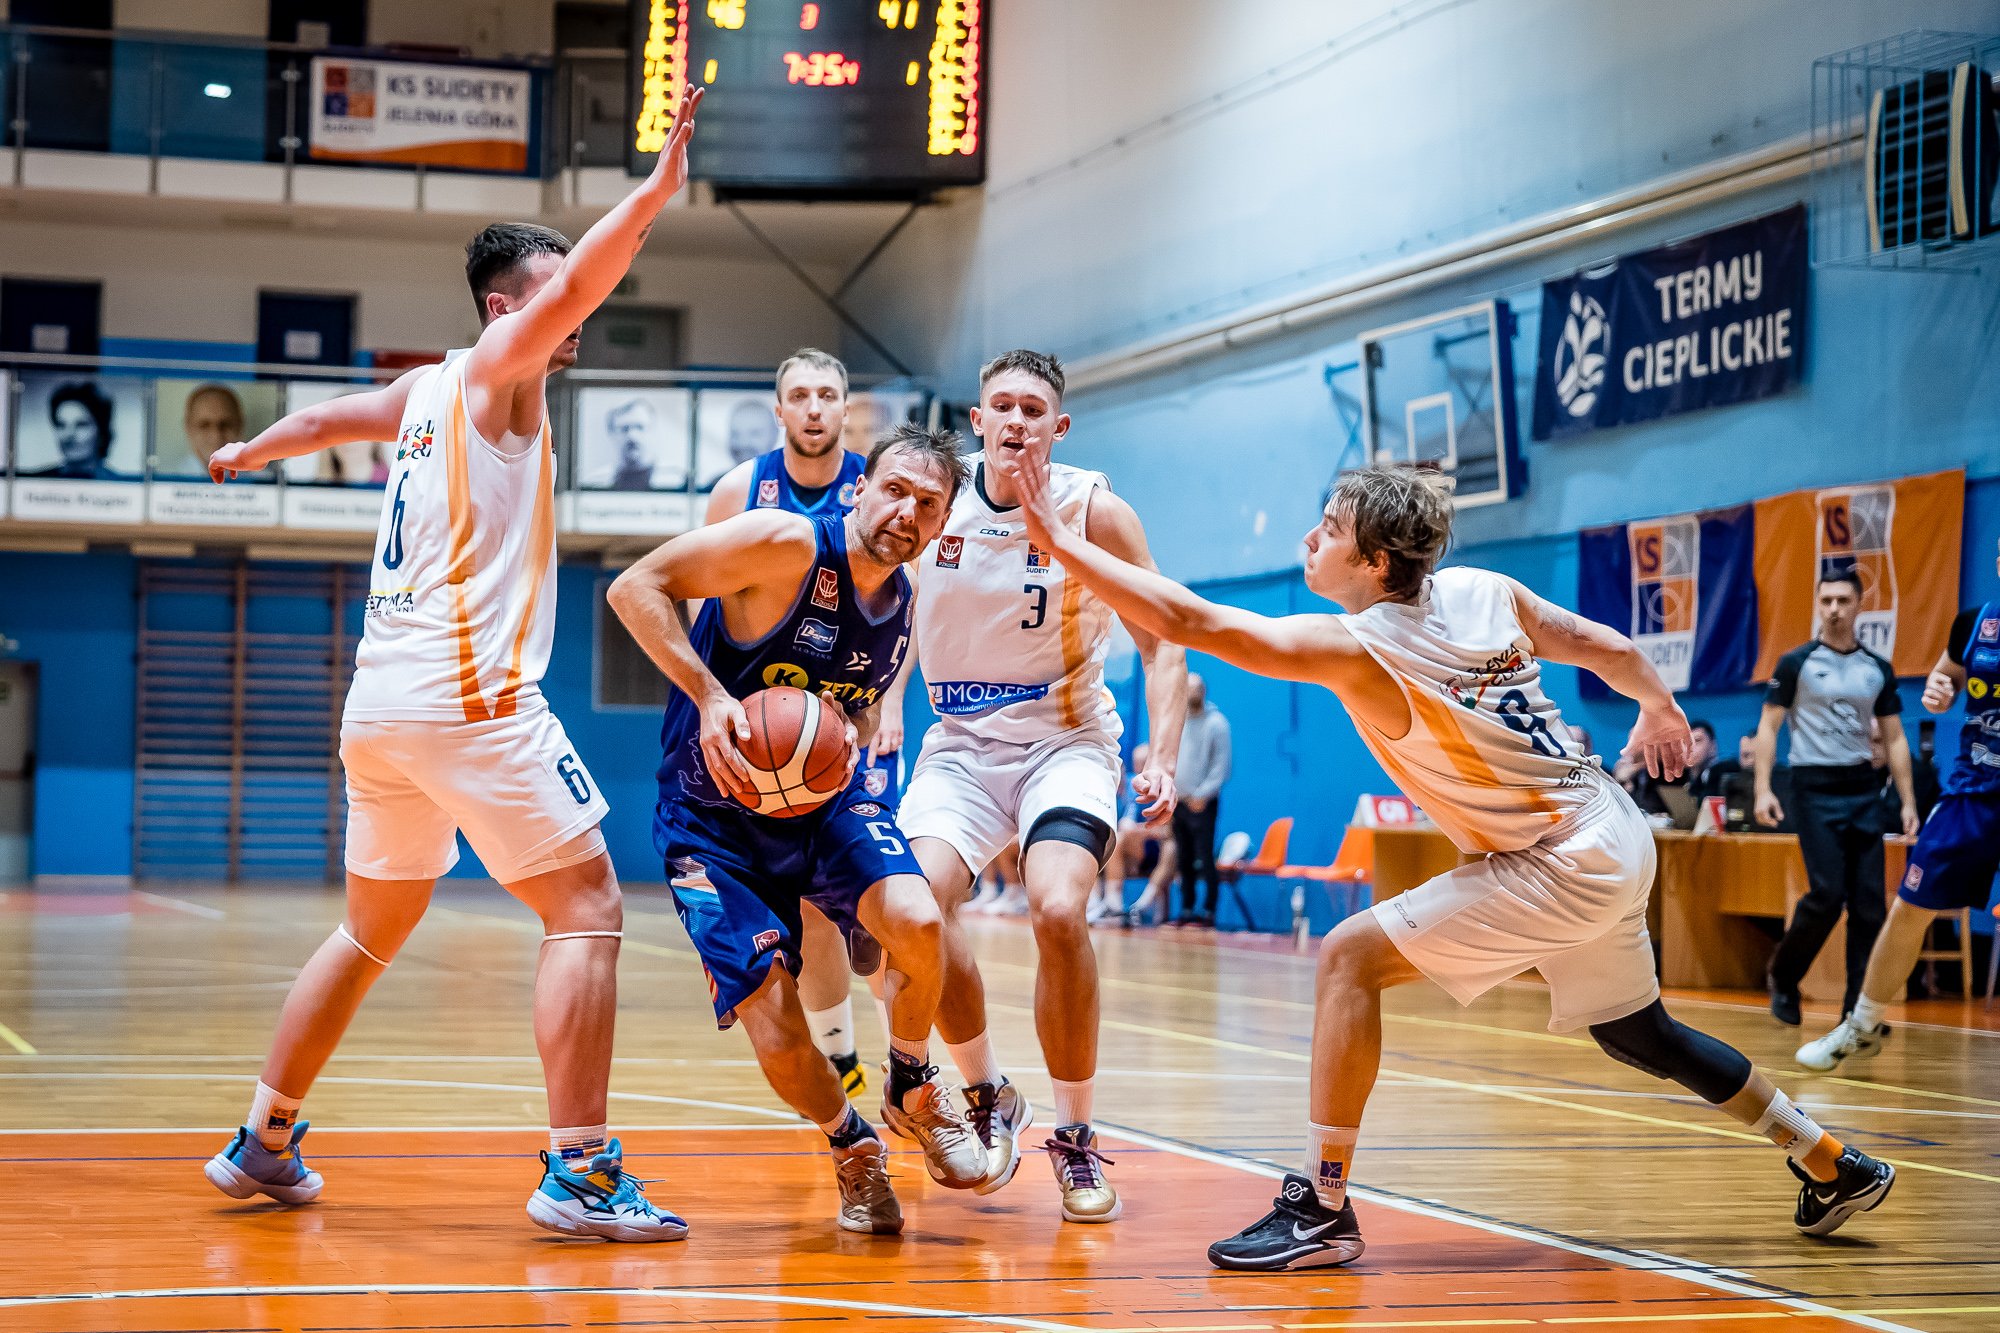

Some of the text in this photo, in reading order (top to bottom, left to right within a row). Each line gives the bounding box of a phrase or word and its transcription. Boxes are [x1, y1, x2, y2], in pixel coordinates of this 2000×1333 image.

[387, 75, 518, 103] KS SUDETY
[1654, 250, 1763, 324] TERMY
[1622, 308, 1793, 393] CIEPLICKIE
[979, 528, 1010, 537] COLO
[1021, 583, 1048, 630] 3
[1859, 620, 1892, 646] ETY
[557, 753, 591, 805] 6
[865, 821, 905, 856] 5
